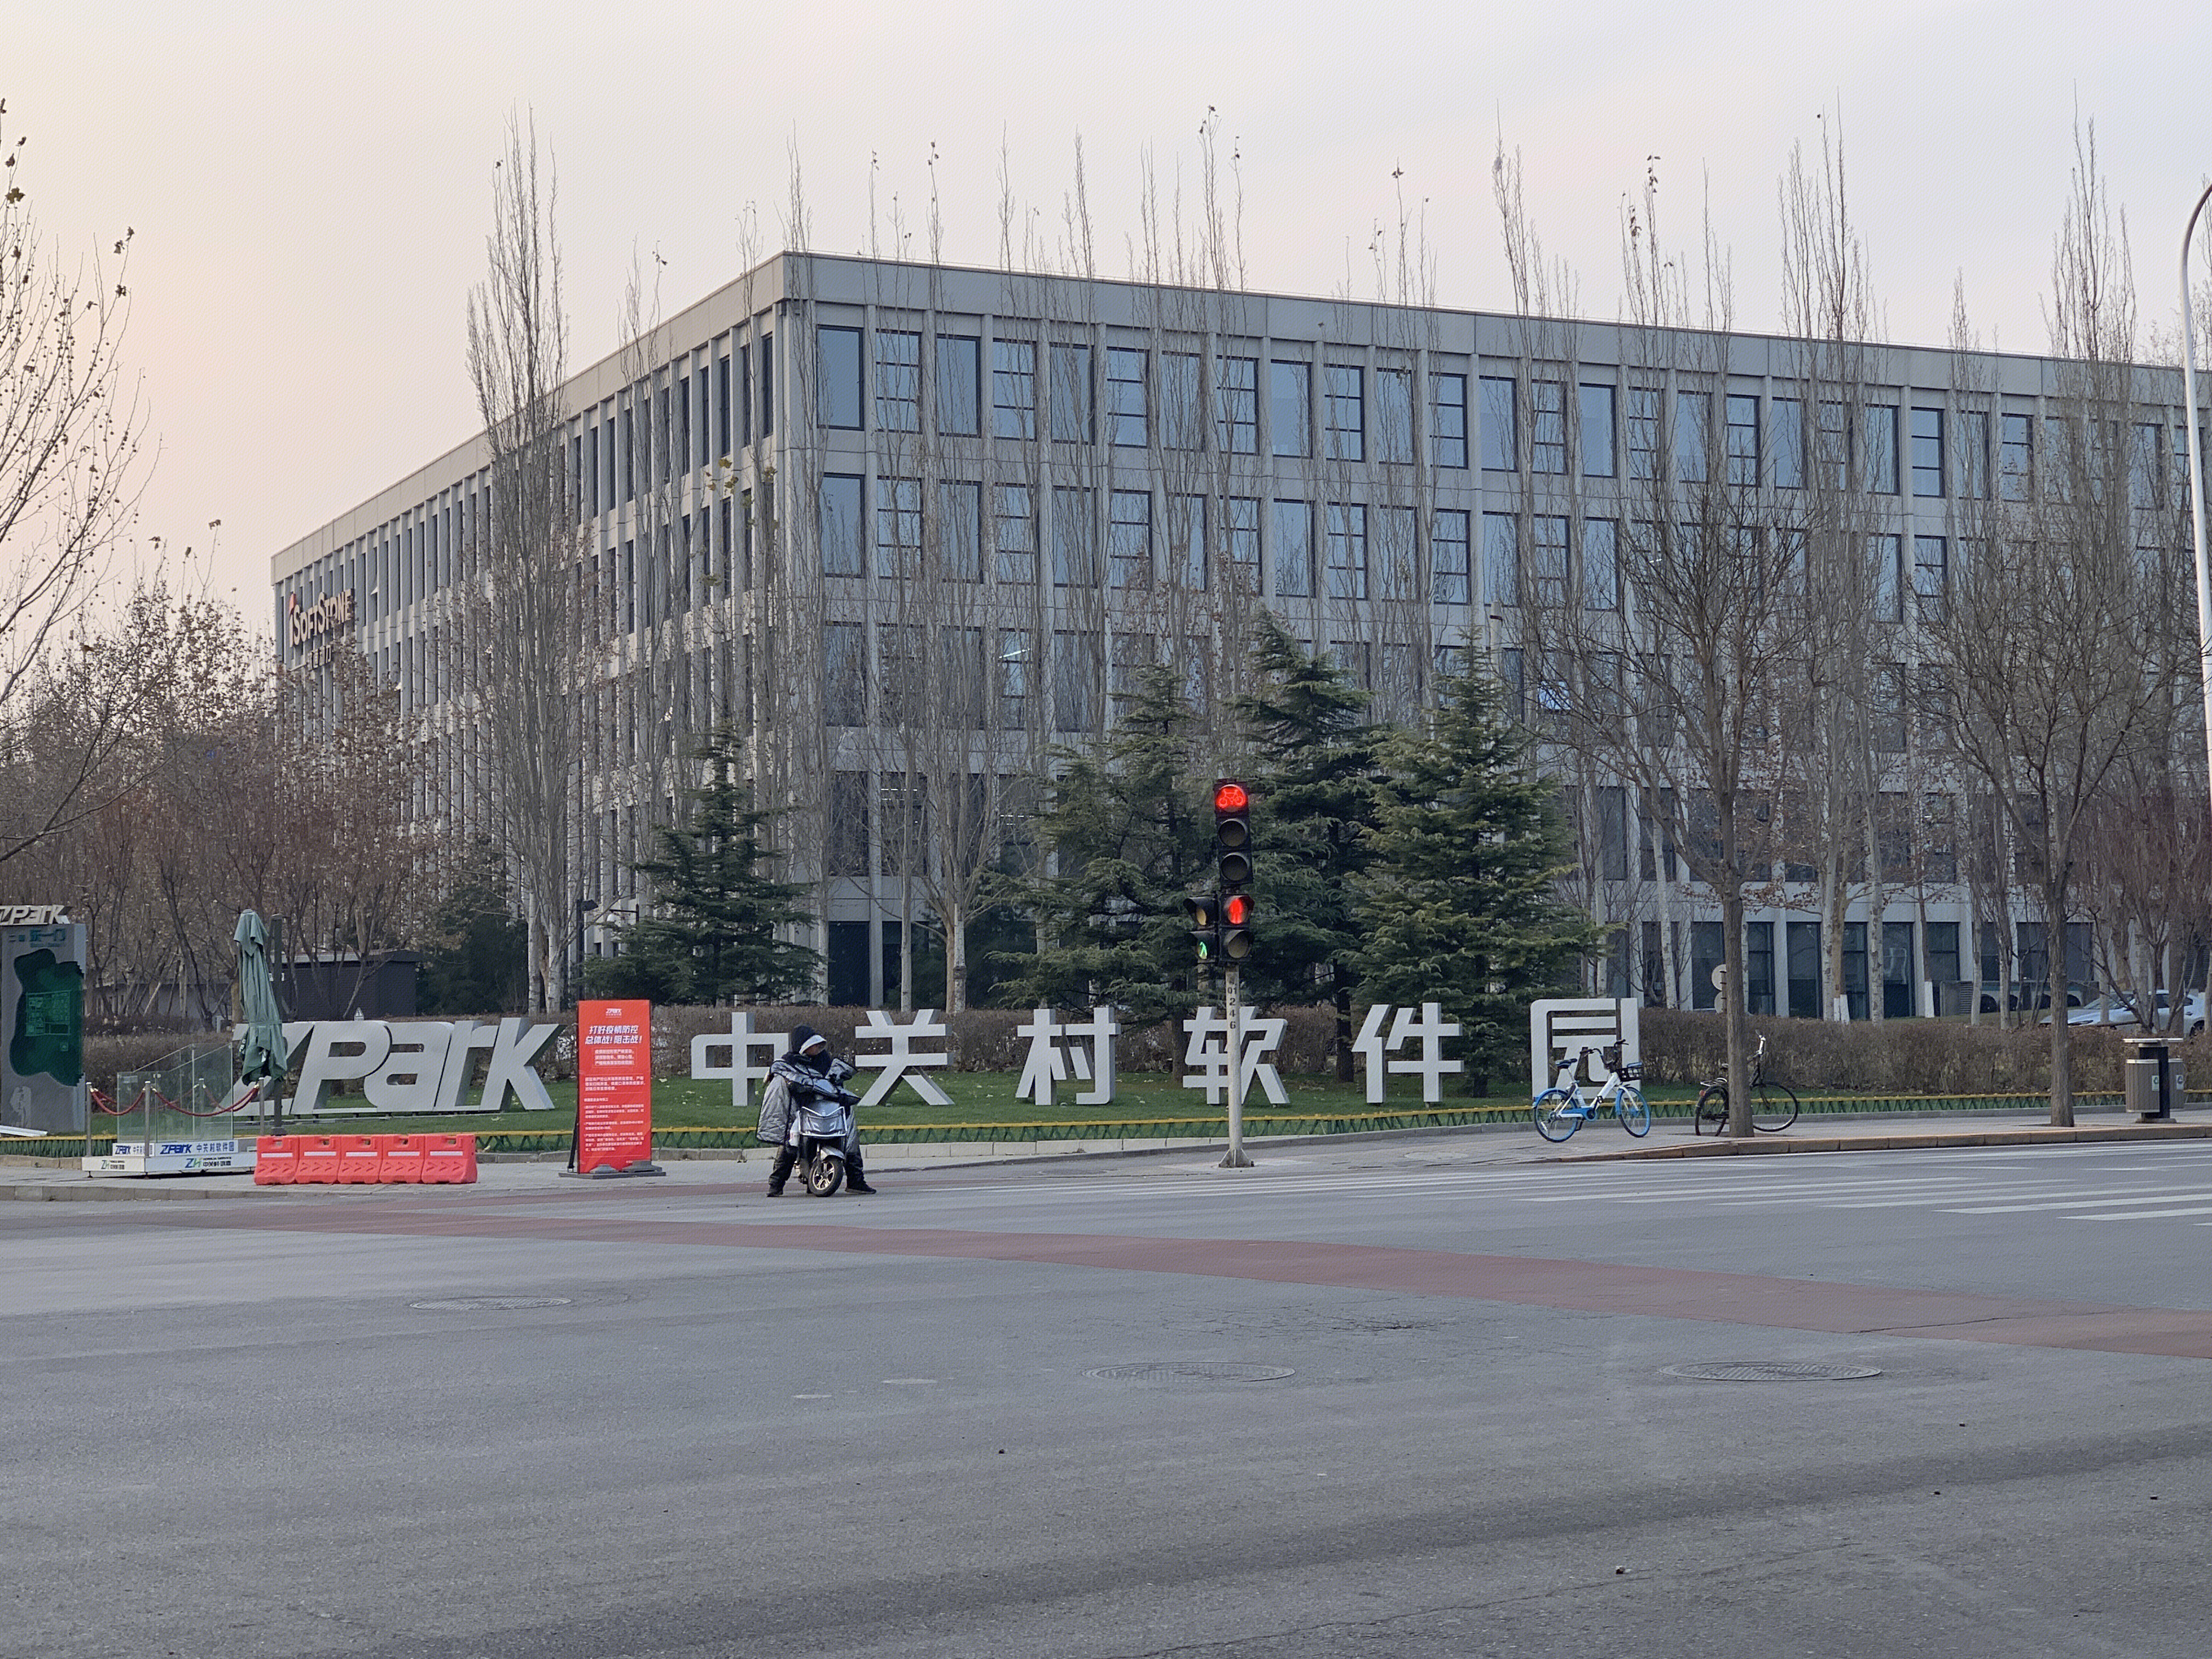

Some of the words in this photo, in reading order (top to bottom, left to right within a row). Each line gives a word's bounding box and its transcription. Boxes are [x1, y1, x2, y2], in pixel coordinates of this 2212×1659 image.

[691, 998, 1641, 1107] 中关村软件园
[160, 1144, 193, 1154] ZPark
